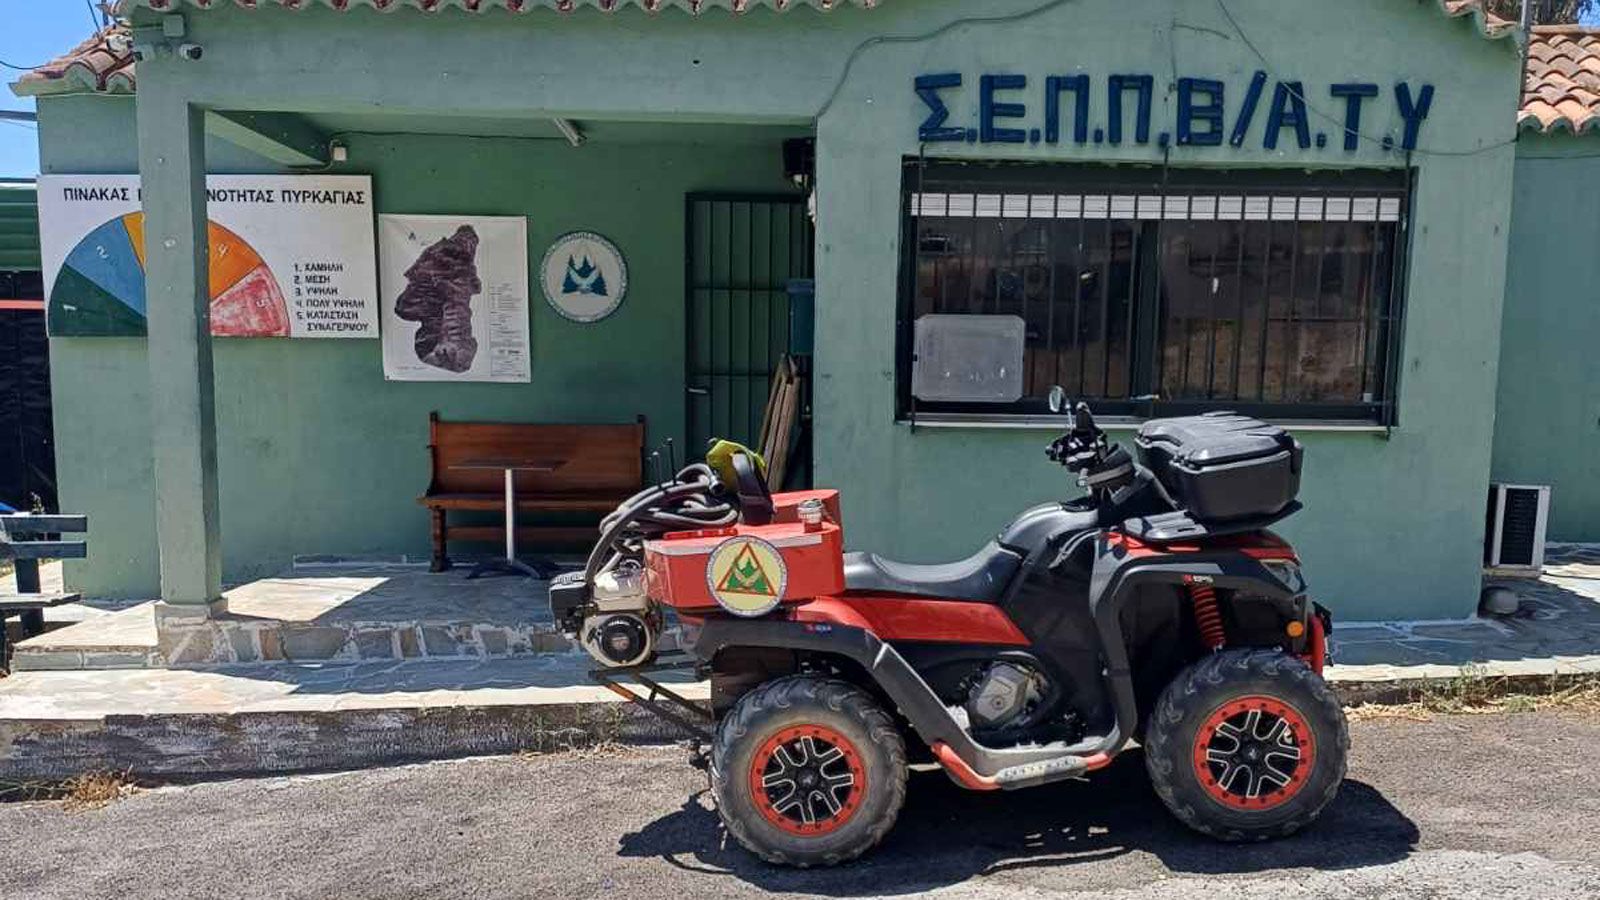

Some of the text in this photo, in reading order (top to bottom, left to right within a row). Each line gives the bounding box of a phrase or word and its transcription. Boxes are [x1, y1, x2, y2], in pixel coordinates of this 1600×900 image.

[63, 187, 130, 202] ΠΙΝΑΚΑΣ
[281, 189, 365, 204] ΠΥΡΚΑΓΙΑΣ
[304, 263, 344, 272] ΧΑΜΗΛΗ
[305, 275, 331, 284] ΜΕΣΗ
[306, 287, 338, 295] ΥΨΗΛΗ
[306, 299, 330, 308] ΠΟΛΥ
[332, 299, 365, 309] ΥΨΗΛΗ
[306, 310, 359, 320] ΚΑΤΑΣΤΑΣΗ
[307, 322, 369, 331] ΣΥΝΑΓΕΡΜΟΥ
